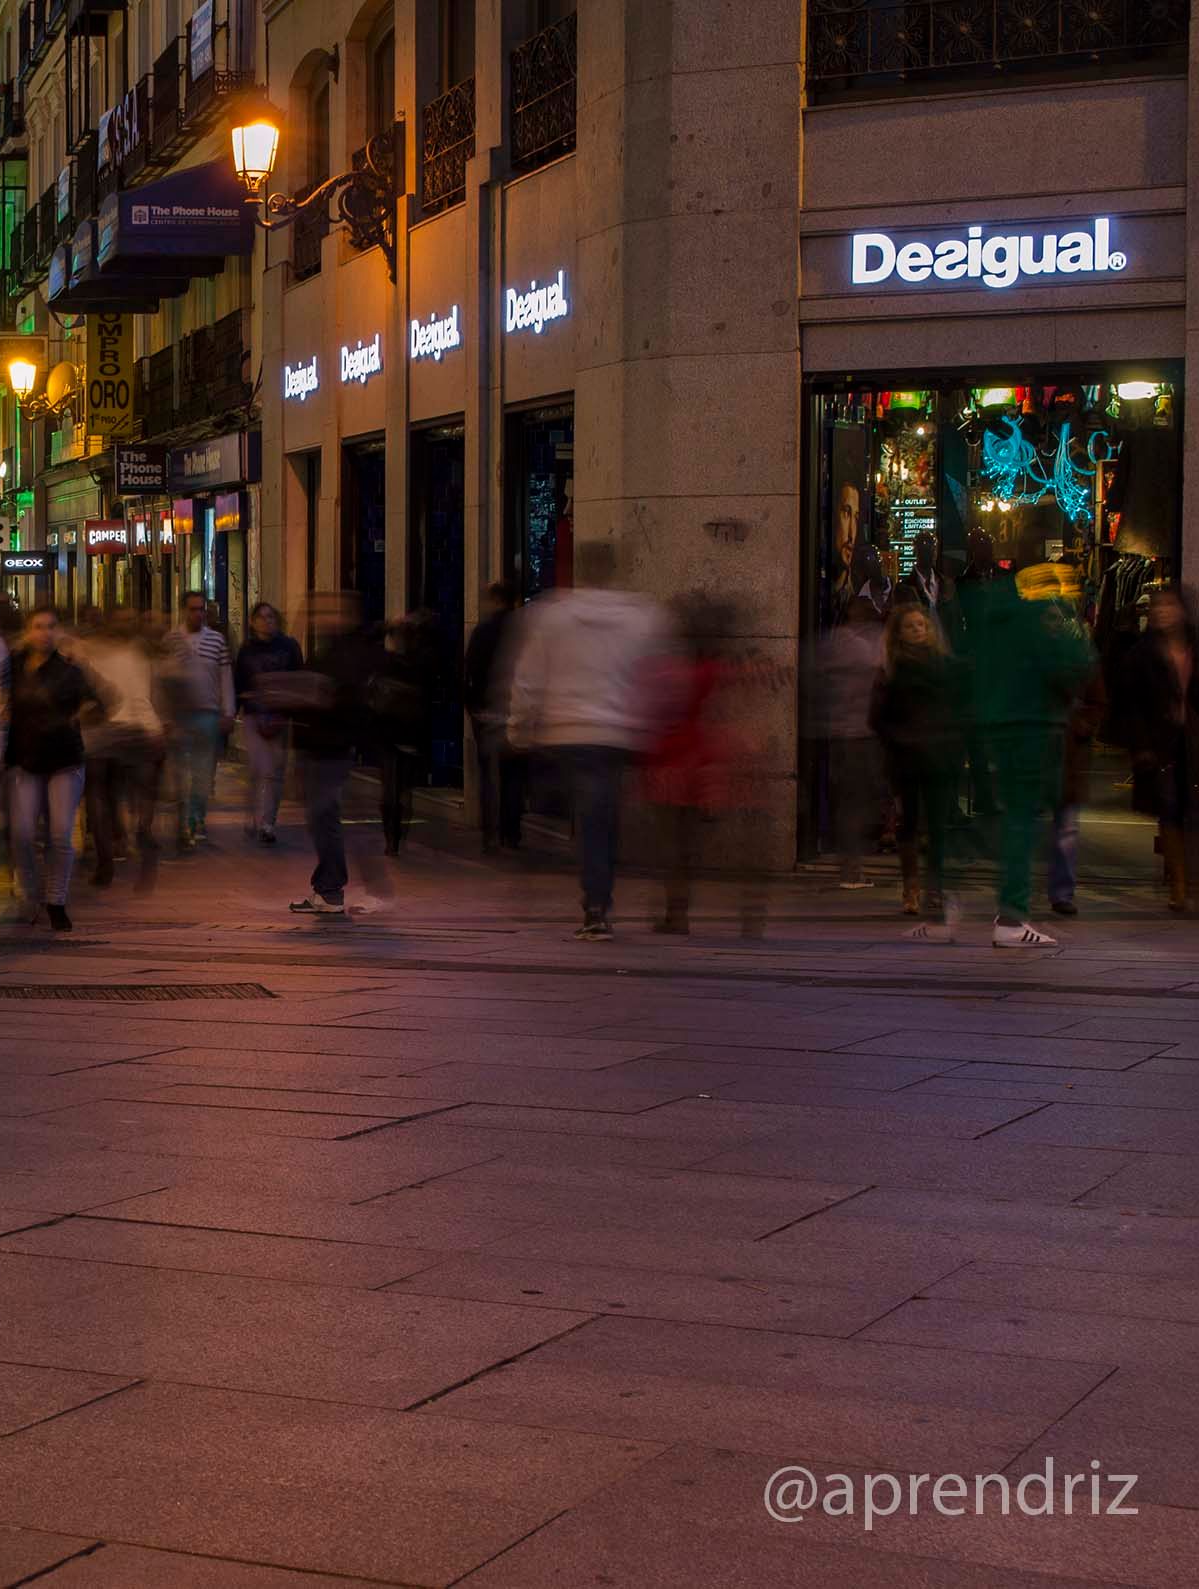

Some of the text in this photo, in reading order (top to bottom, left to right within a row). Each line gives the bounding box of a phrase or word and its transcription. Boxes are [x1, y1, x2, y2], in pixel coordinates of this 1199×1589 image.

[151, 206, 240, 217] The Phone House
[852, 218, 1127, 288] Desigual
[97, 313, 123, 377] OMPRO
[90, 380, 130, 410] ORO
[120, 450, 148, 462] The
[120, 462, 163, 474] Phone
[120, 474, 163, 485] House
[88, 529, 128, 545] CAMPER
[4, 559, 44, 568] GEOX
